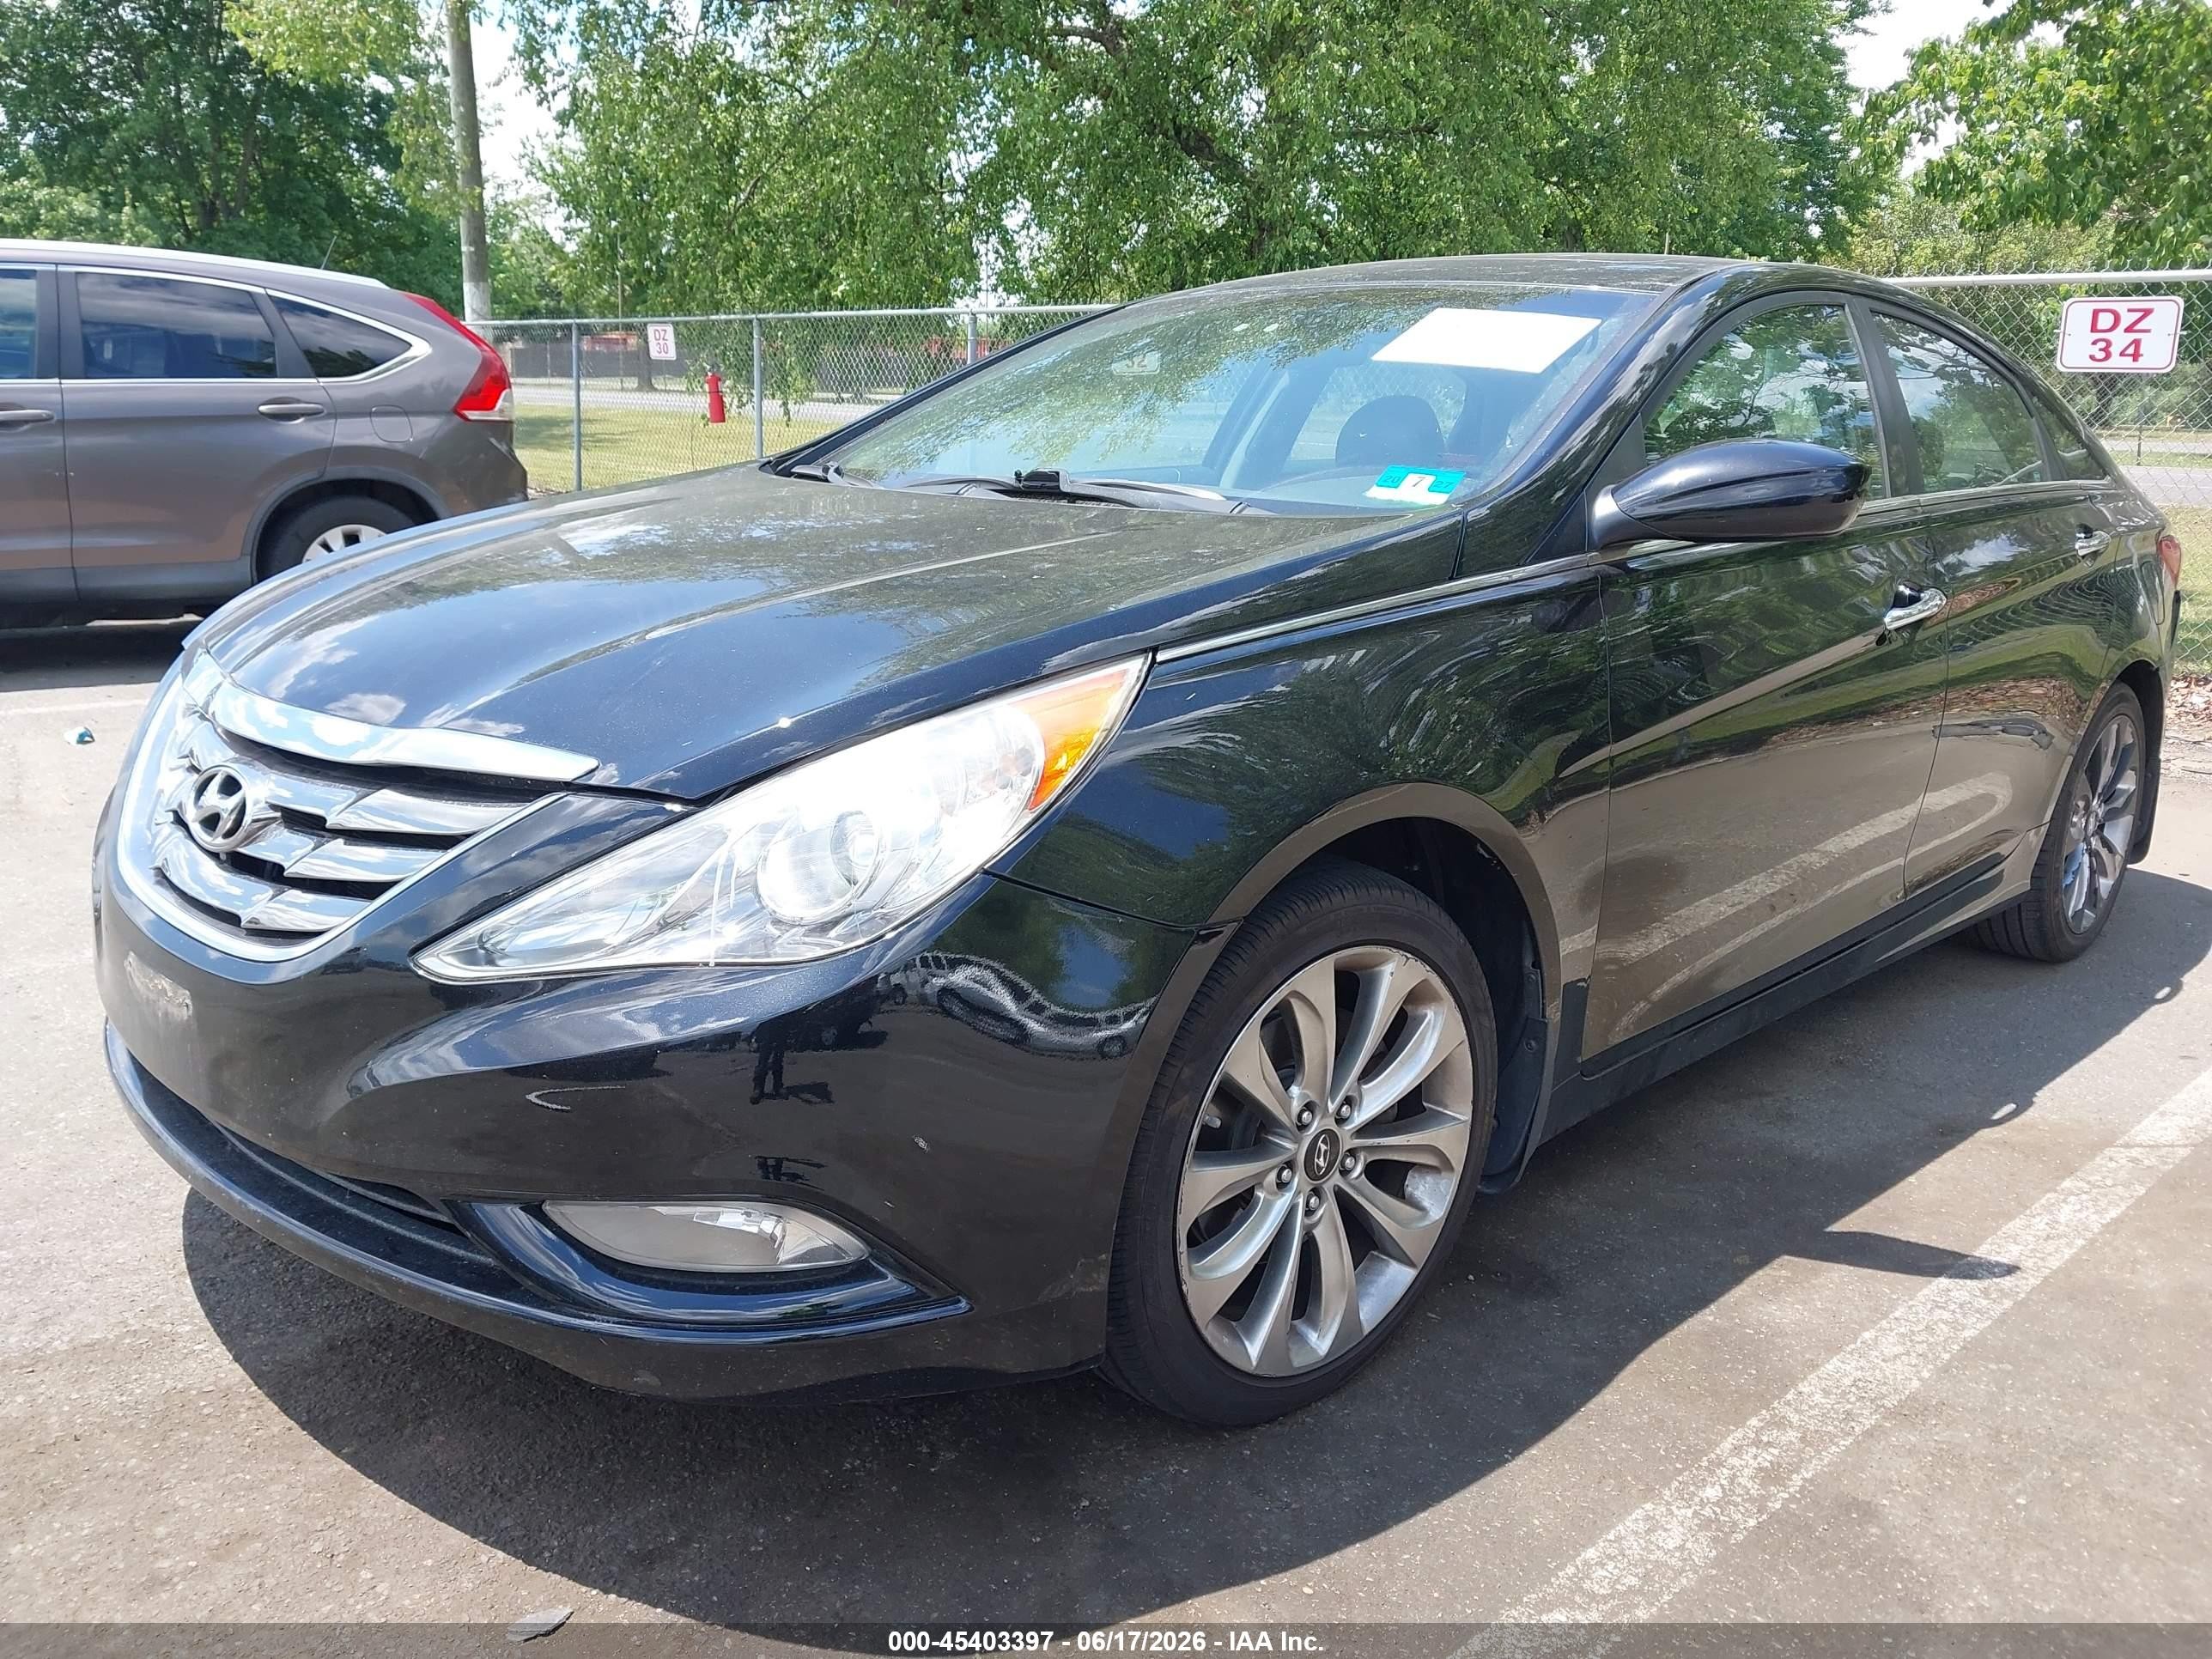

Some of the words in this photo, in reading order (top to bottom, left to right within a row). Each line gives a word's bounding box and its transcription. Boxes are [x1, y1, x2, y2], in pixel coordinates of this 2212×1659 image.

[2090, 307, 2154, 333] DZ
[653, 329, 668, 341] DZ
[656, 342, 669, 355] 30
[2088, 337, 2143, 362] 34
[1382, 475, 1401, 483] 20
[1413, 476, 1425, 488] 7
[1434, 480, 1455, 489] 27
